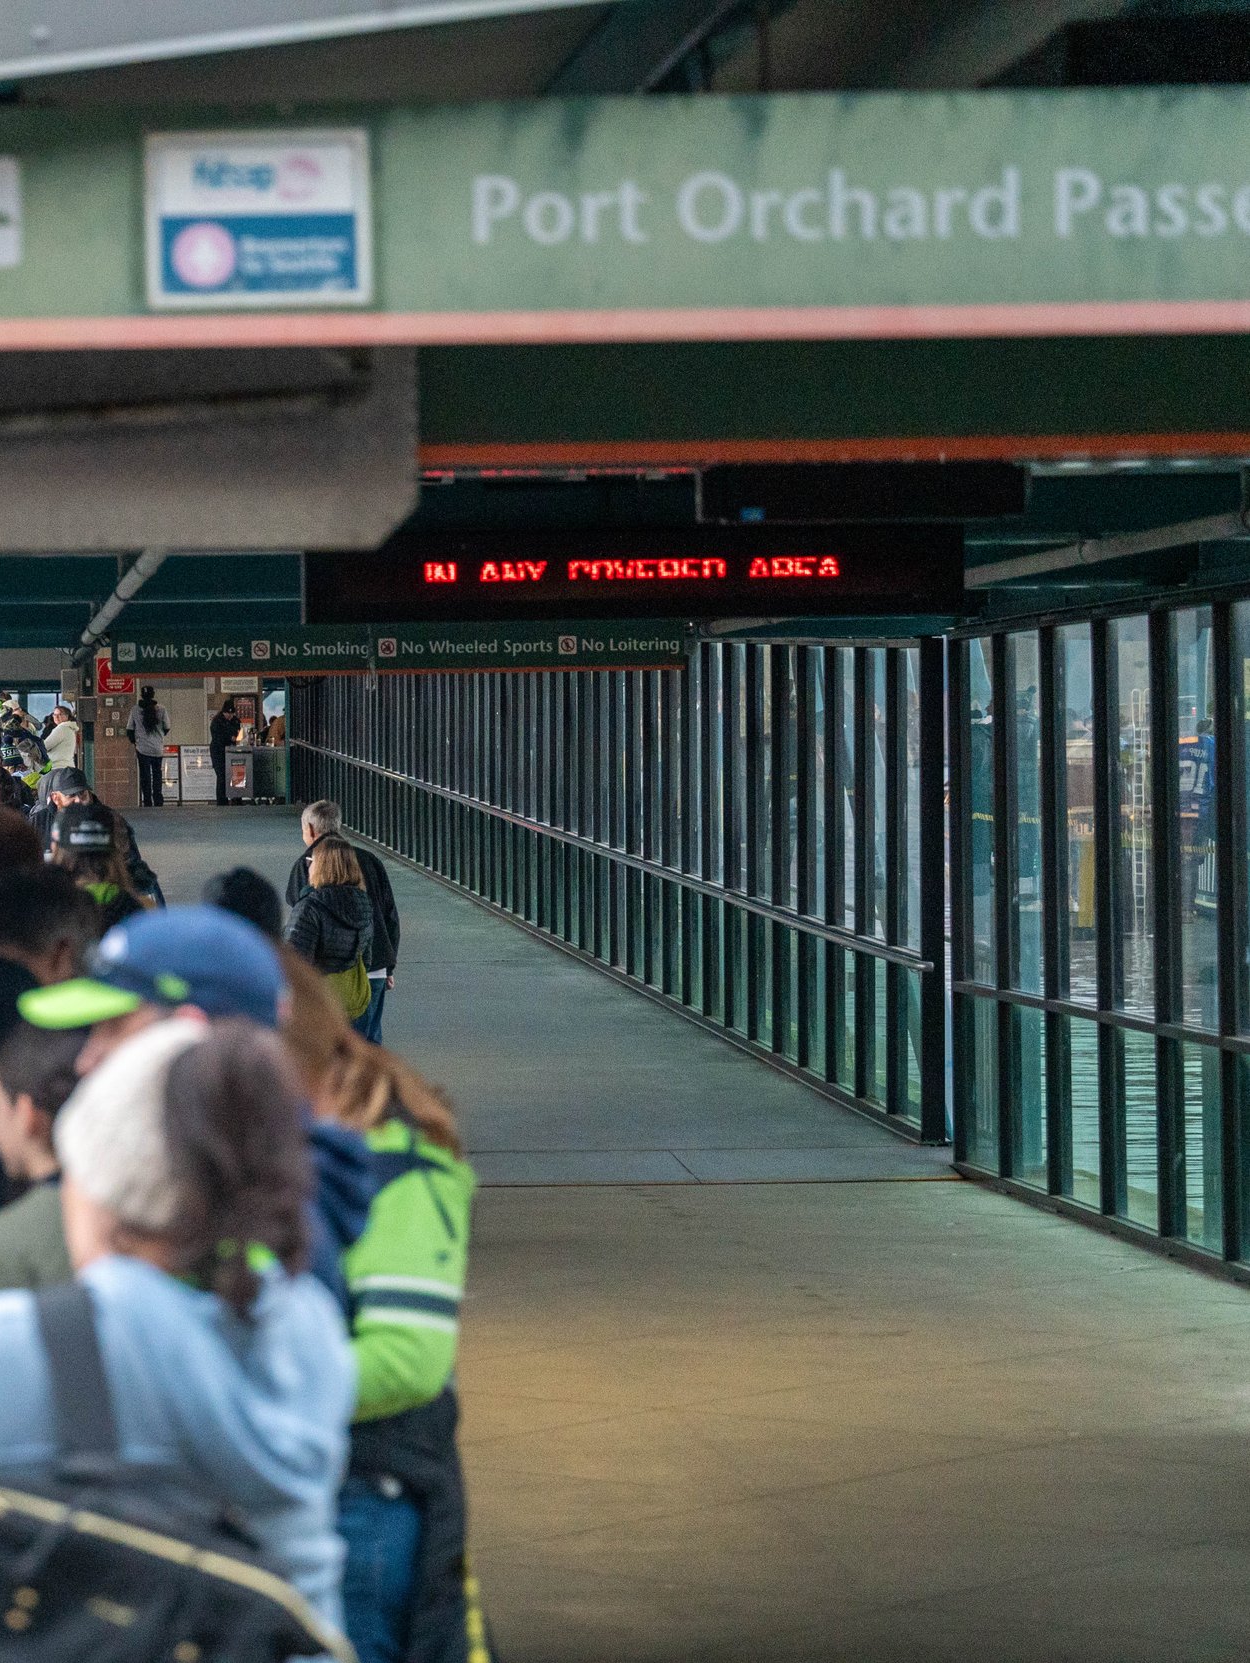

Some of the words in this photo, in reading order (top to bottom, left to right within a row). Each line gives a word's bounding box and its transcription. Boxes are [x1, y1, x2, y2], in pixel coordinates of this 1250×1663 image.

[473, 174, 649, 246] Port
[676, 167, 1018, 243] Orchard
[140, 644, 178, 659] Walk
[183, 643, 244, 662] Bicycles
[275, 643, 298, 657] No
[302, 641, 369, 659] Smoking
[401, 641, 424, 655] No
[429, 639, 498, 654] Wheeled
[503, 639, 553, 657] Sports
[581, 639, 605, 652] No
[609, 637, 680, 655] Loitering
